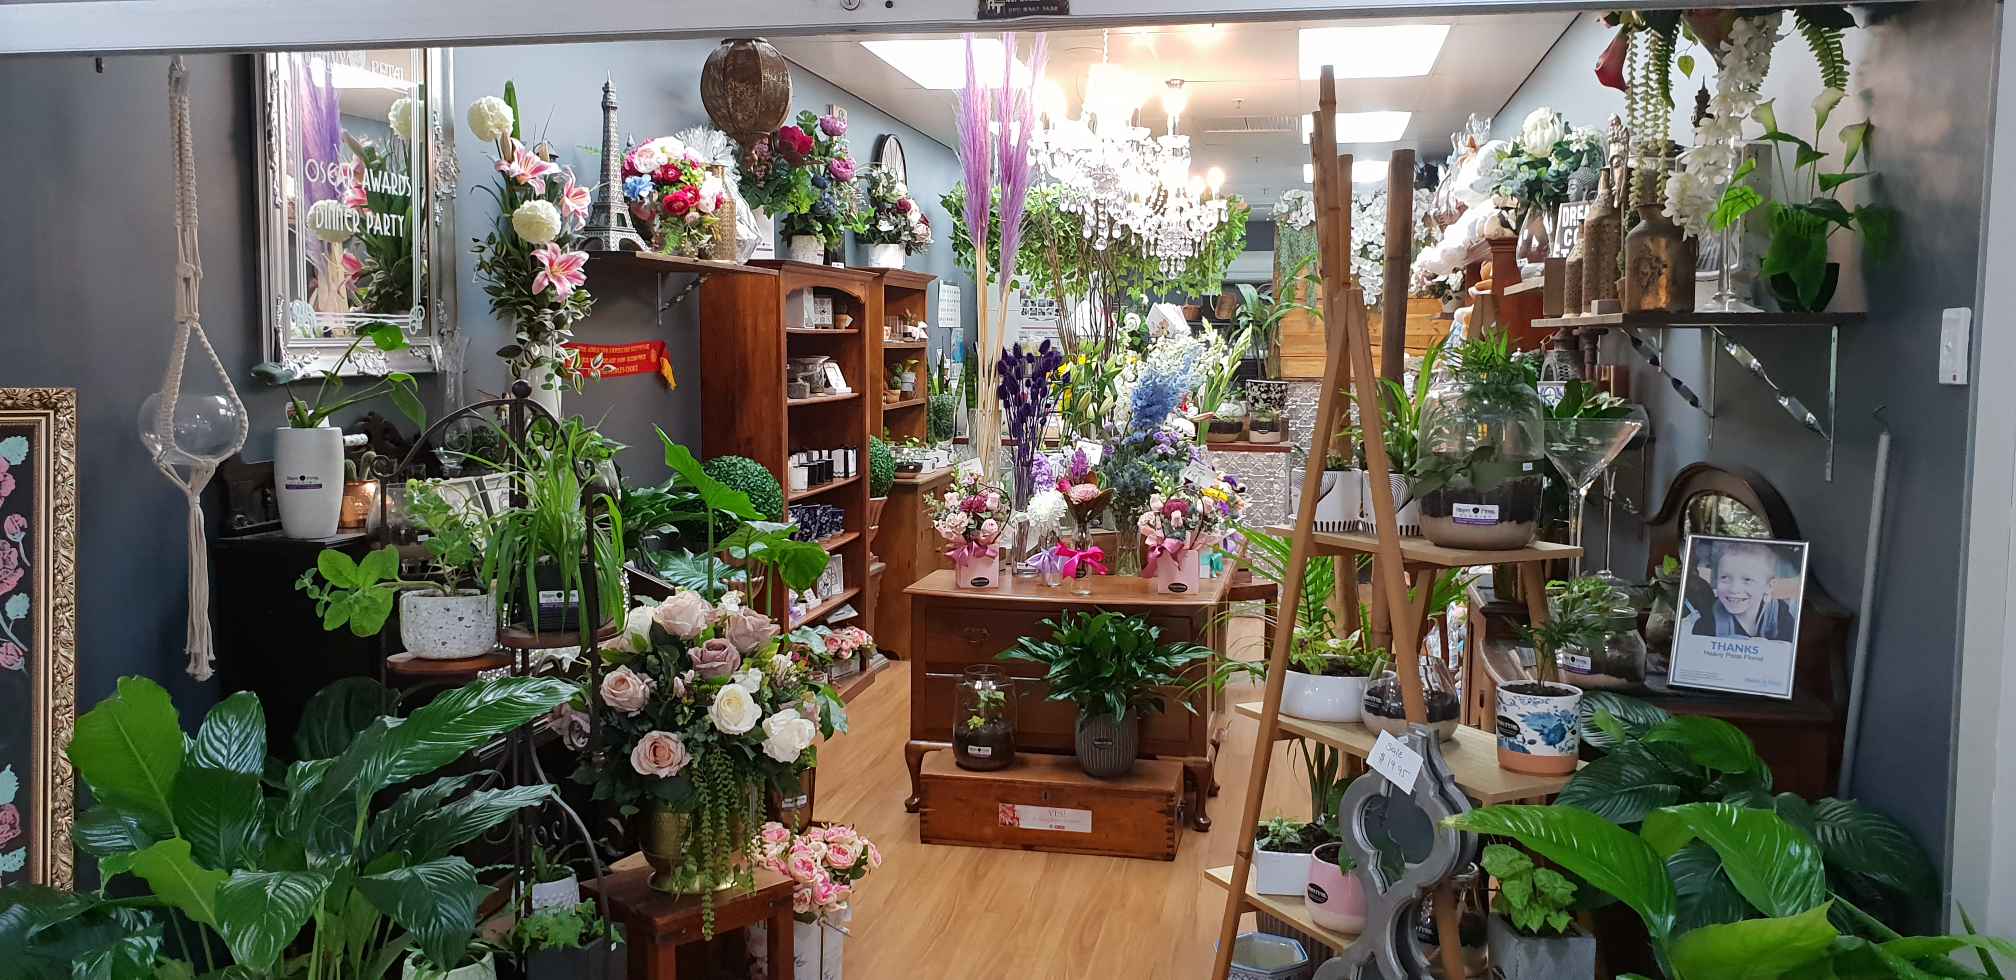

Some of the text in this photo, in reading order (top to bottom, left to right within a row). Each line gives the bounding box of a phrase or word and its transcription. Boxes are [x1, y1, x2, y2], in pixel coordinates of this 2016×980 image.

[305, 158, 412, 197] OSCAR AWARDS
[315, 204, 405, 238] DINNER PARTY
[1711, 641, 1760, 655] THANKS
